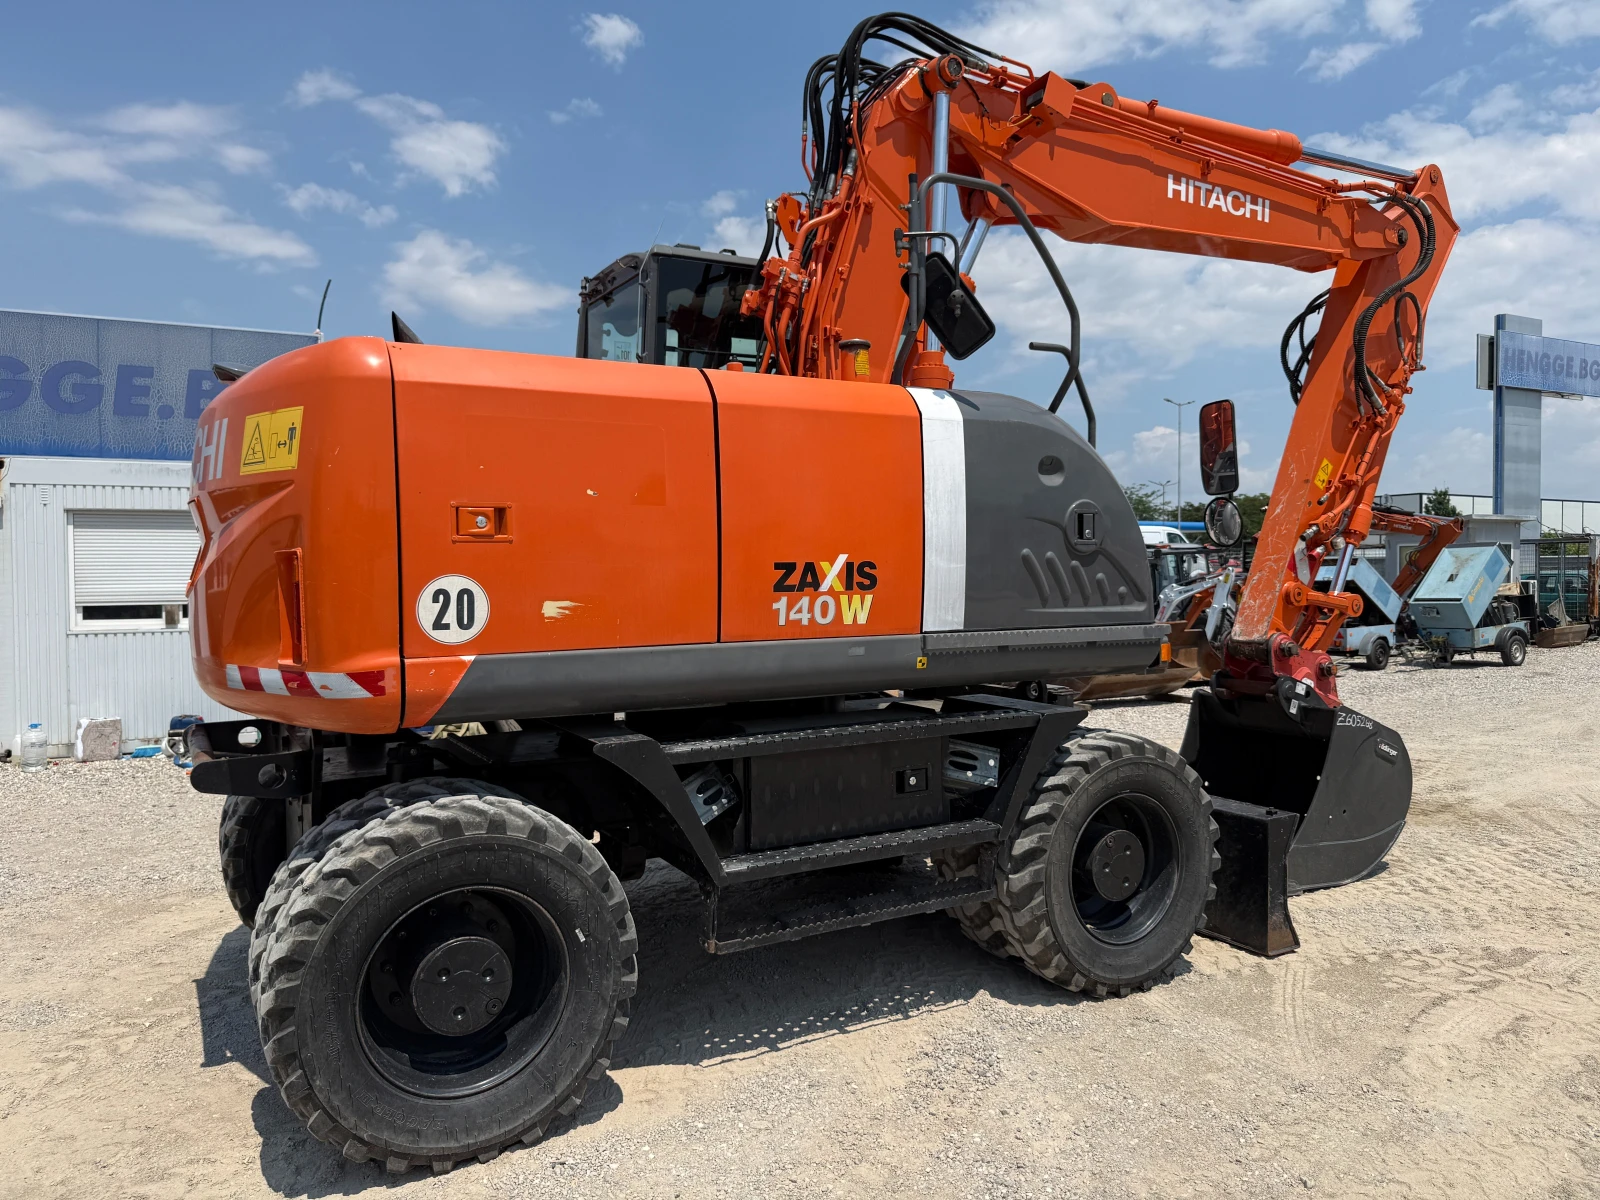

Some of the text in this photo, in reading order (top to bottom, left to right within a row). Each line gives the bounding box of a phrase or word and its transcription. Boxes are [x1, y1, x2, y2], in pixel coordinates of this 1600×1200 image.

[1167, 174, 1270, 223] HITACHI
[1503, 347, 1600, 381] HENGGE.BG
[772, 554, 878, 592] ZAXIS
[431, 587, 476, 631] 20
[772, 594, 874, 626] 140W
